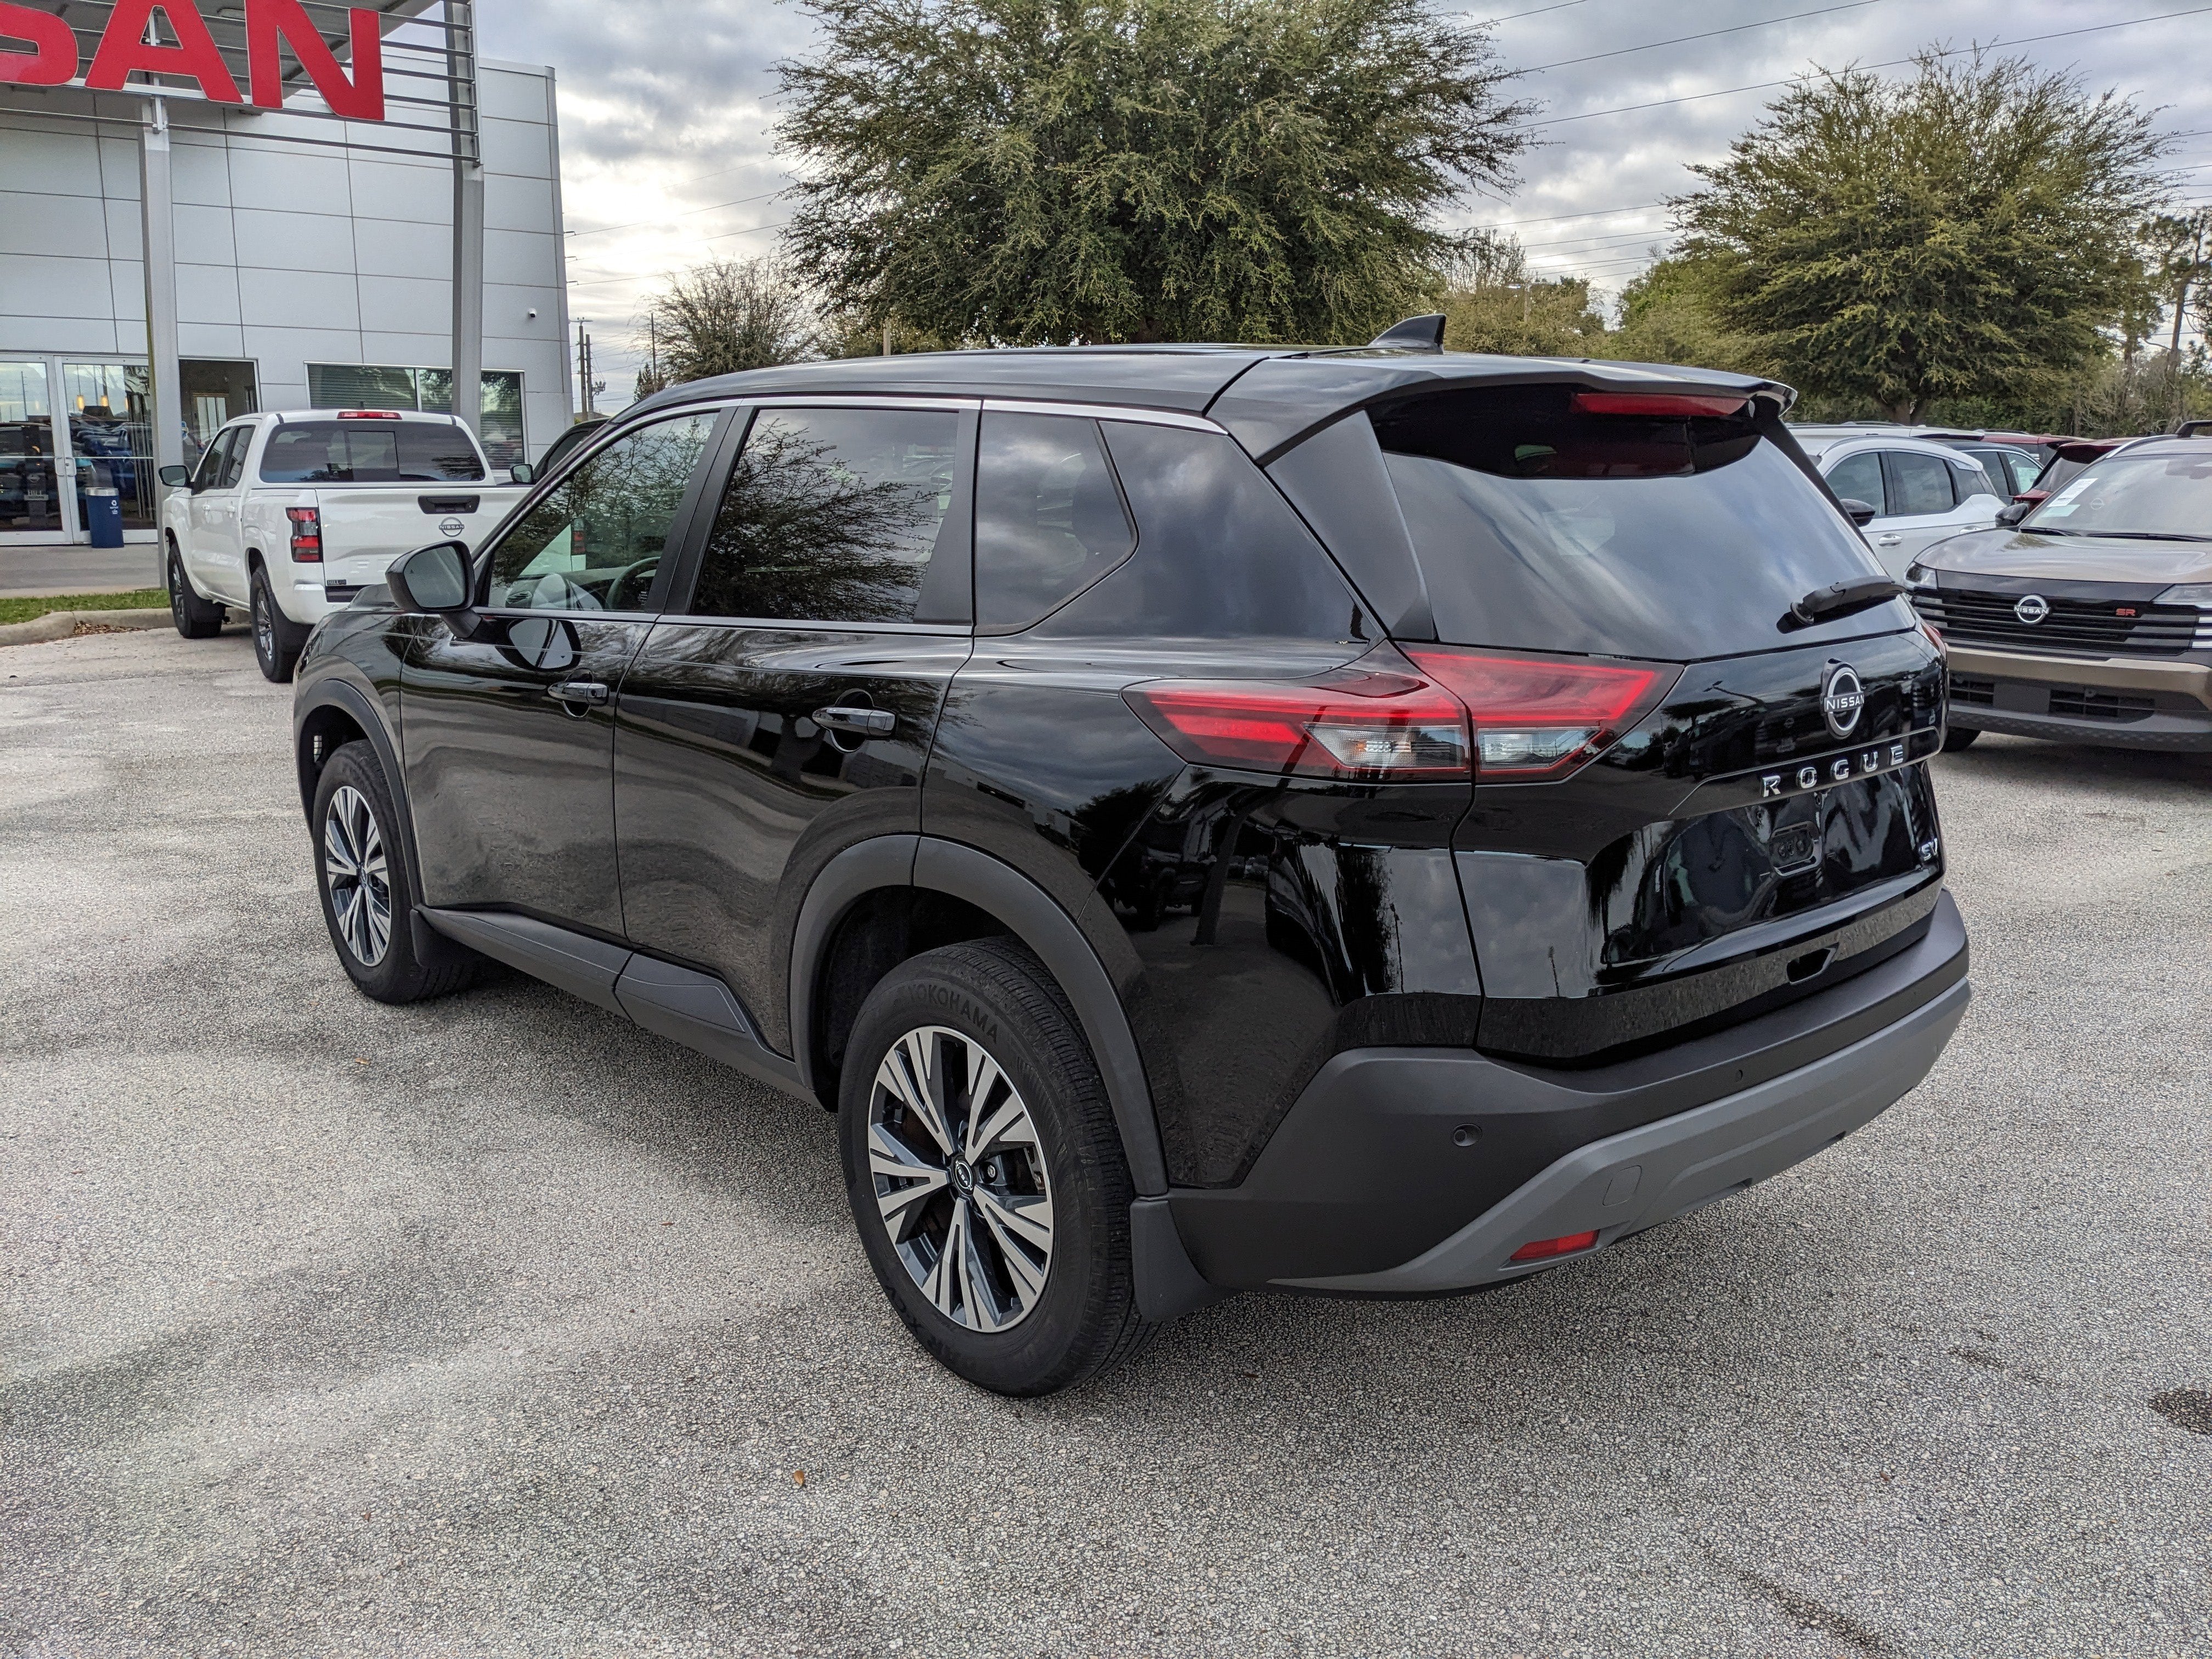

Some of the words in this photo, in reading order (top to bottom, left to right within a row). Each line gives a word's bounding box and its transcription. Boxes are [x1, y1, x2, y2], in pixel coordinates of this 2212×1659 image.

[2115, 608, 2136, 617] SR
[1826, 693, 1865, 710] NISSAN
[1761, 744, 1904, 798] ROGUE
[1921, 838, 1938, 861] SV
[908, 984, 998, 1044] YOKOHAMA
